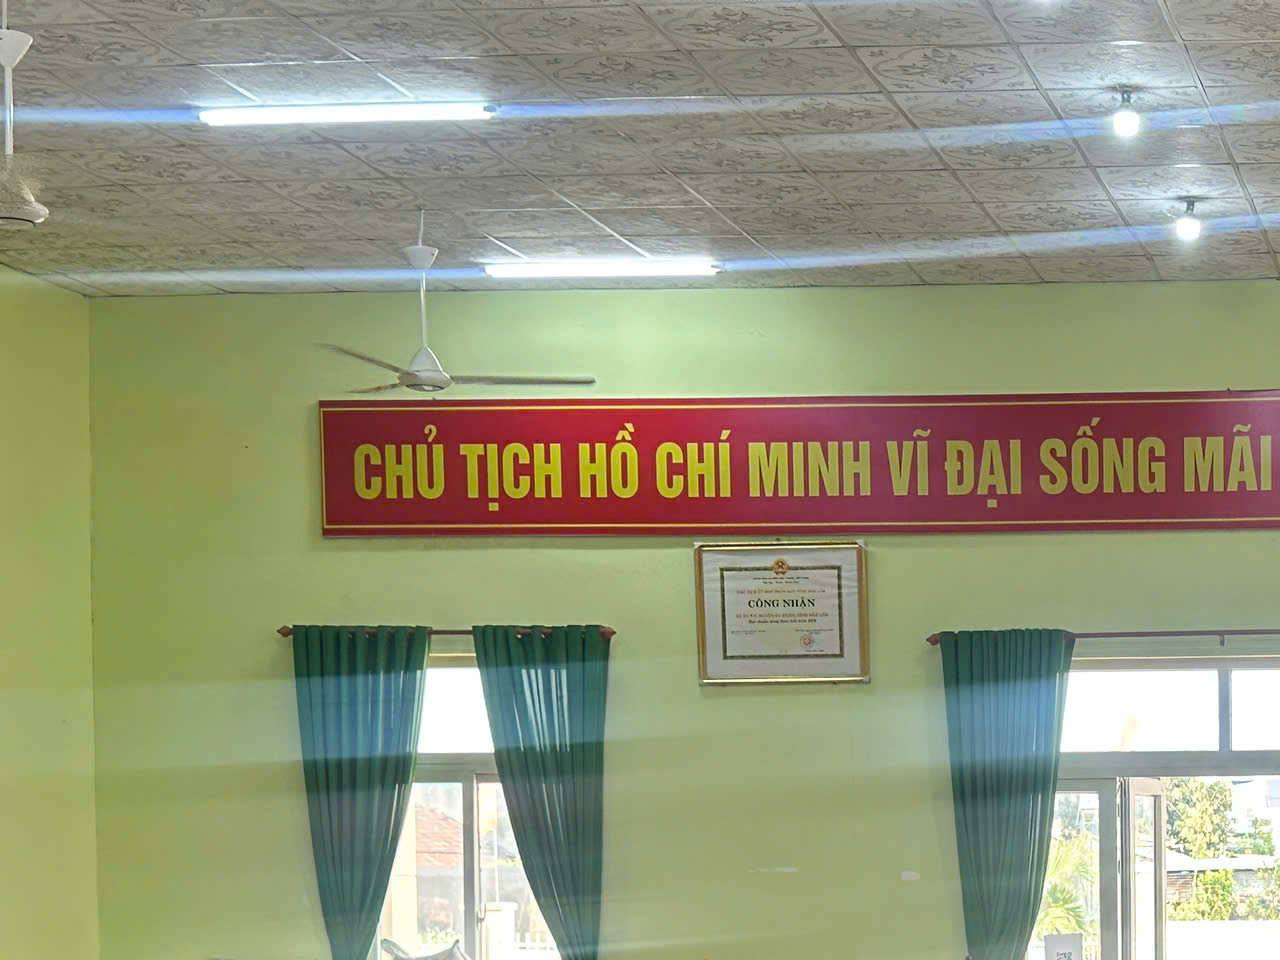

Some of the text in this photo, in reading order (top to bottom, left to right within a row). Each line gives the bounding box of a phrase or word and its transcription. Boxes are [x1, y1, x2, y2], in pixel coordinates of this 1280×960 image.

[355, 425, 444, 499] CHỦ
[460, 443, 562, 511] TỊCH
[579, 423, 638, 498] HỒ
[656, 430, 731, 498] CHÍ
[748, 441, 871, 496] MINH
[888, 430, 930, 495] VĨ
[945, 438, 1022, 507] ĐẠI
[1040, 417, 1165, 494] SỐNG
[1184, 425, 1273, 492] MÃI
[748, 596, 815, 609] CÔNG NHẬN
